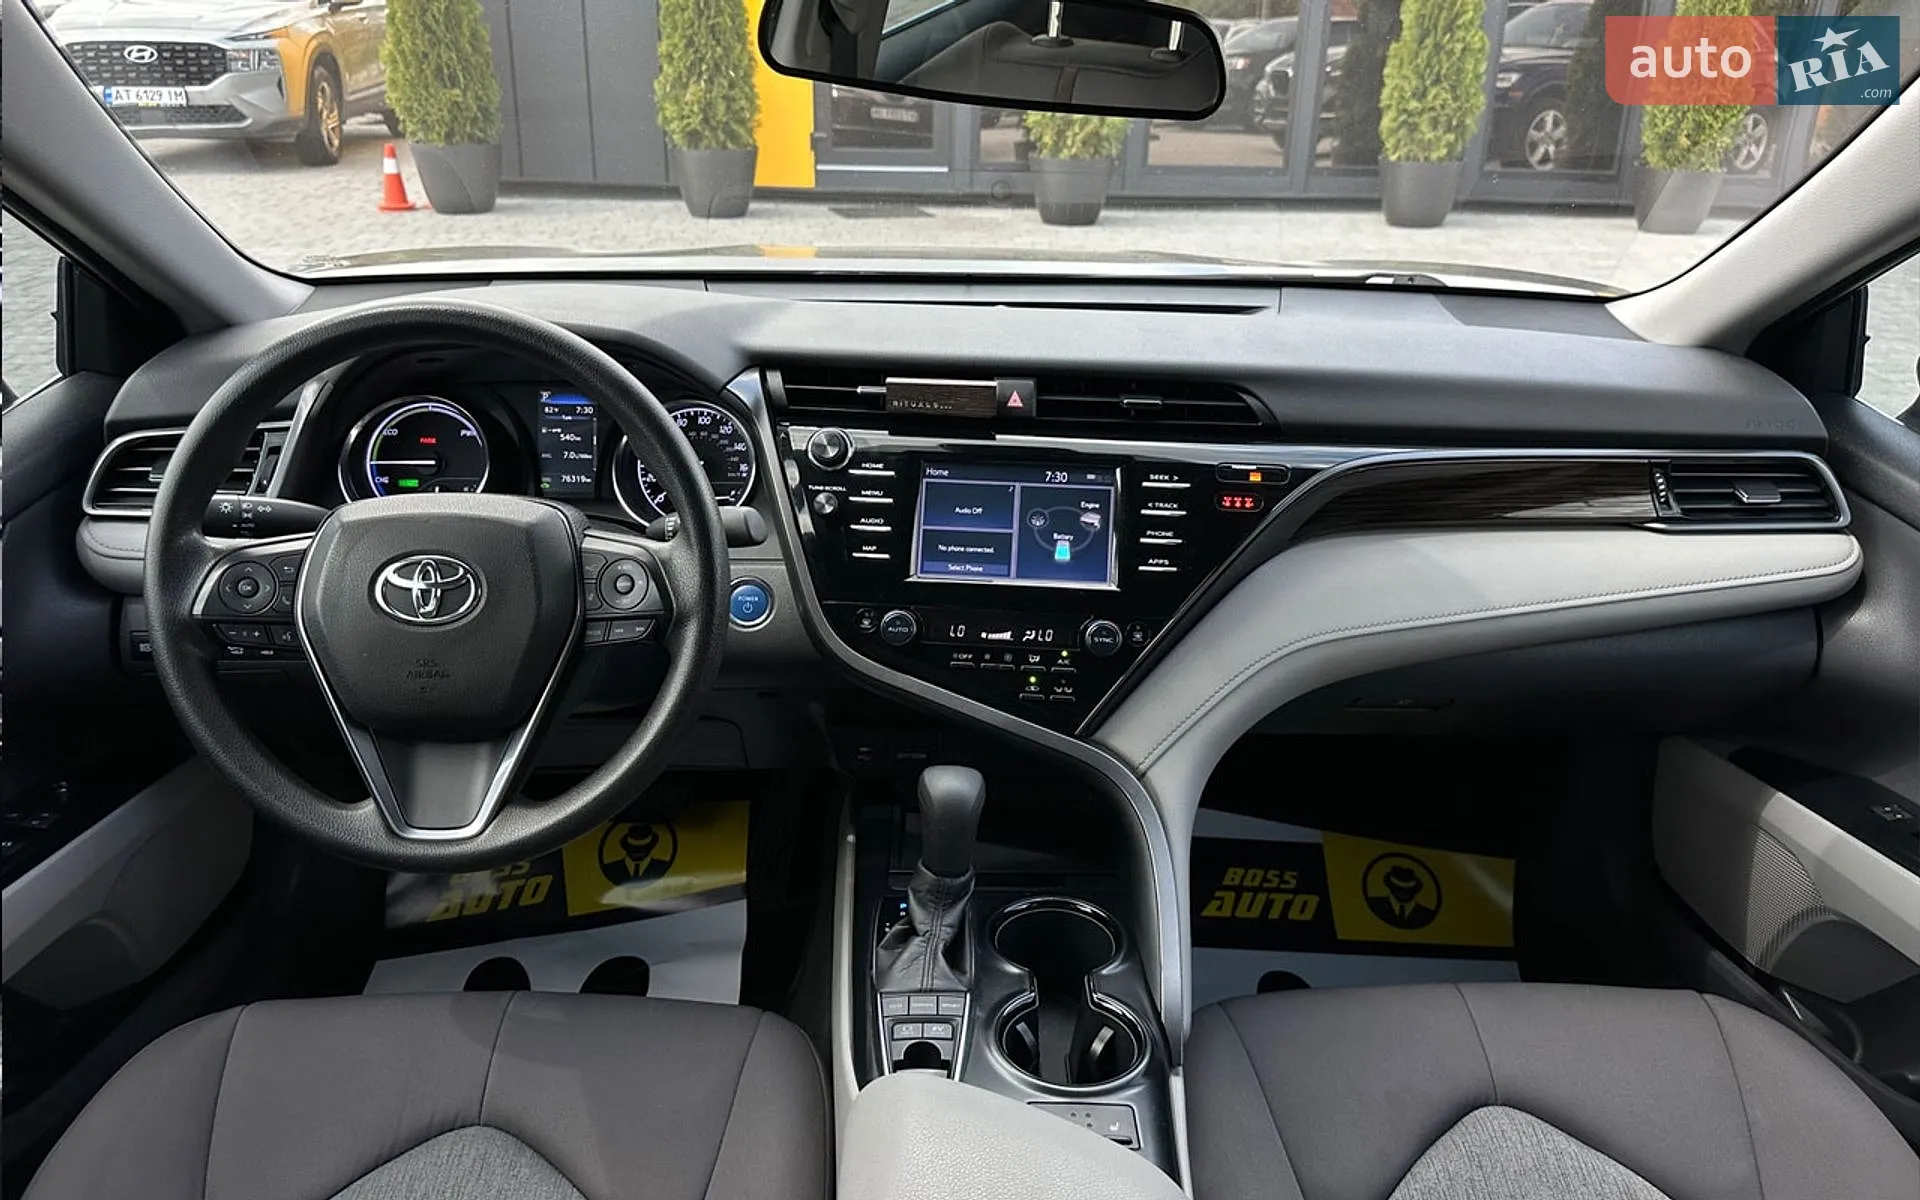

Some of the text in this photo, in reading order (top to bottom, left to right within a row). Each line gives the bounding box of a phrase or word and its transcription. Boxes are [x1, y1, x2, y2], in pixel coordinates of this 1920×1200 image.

[115, 89, 131, 101] AT
[136, 89, 163, 101] 6129
[575, 406, 594, 414] 7:30
[698, 416, 711, 425] 100
[719, 424, 733, 435] 120
[925, 467, 949, 477] Home
[1045, 471, 1068, 483] 7:30
[1222, 867, 1298, 889] BOSS
[426, 875, 553, 922] AUTO
[1201, 892, 1320, 921] AUTO
